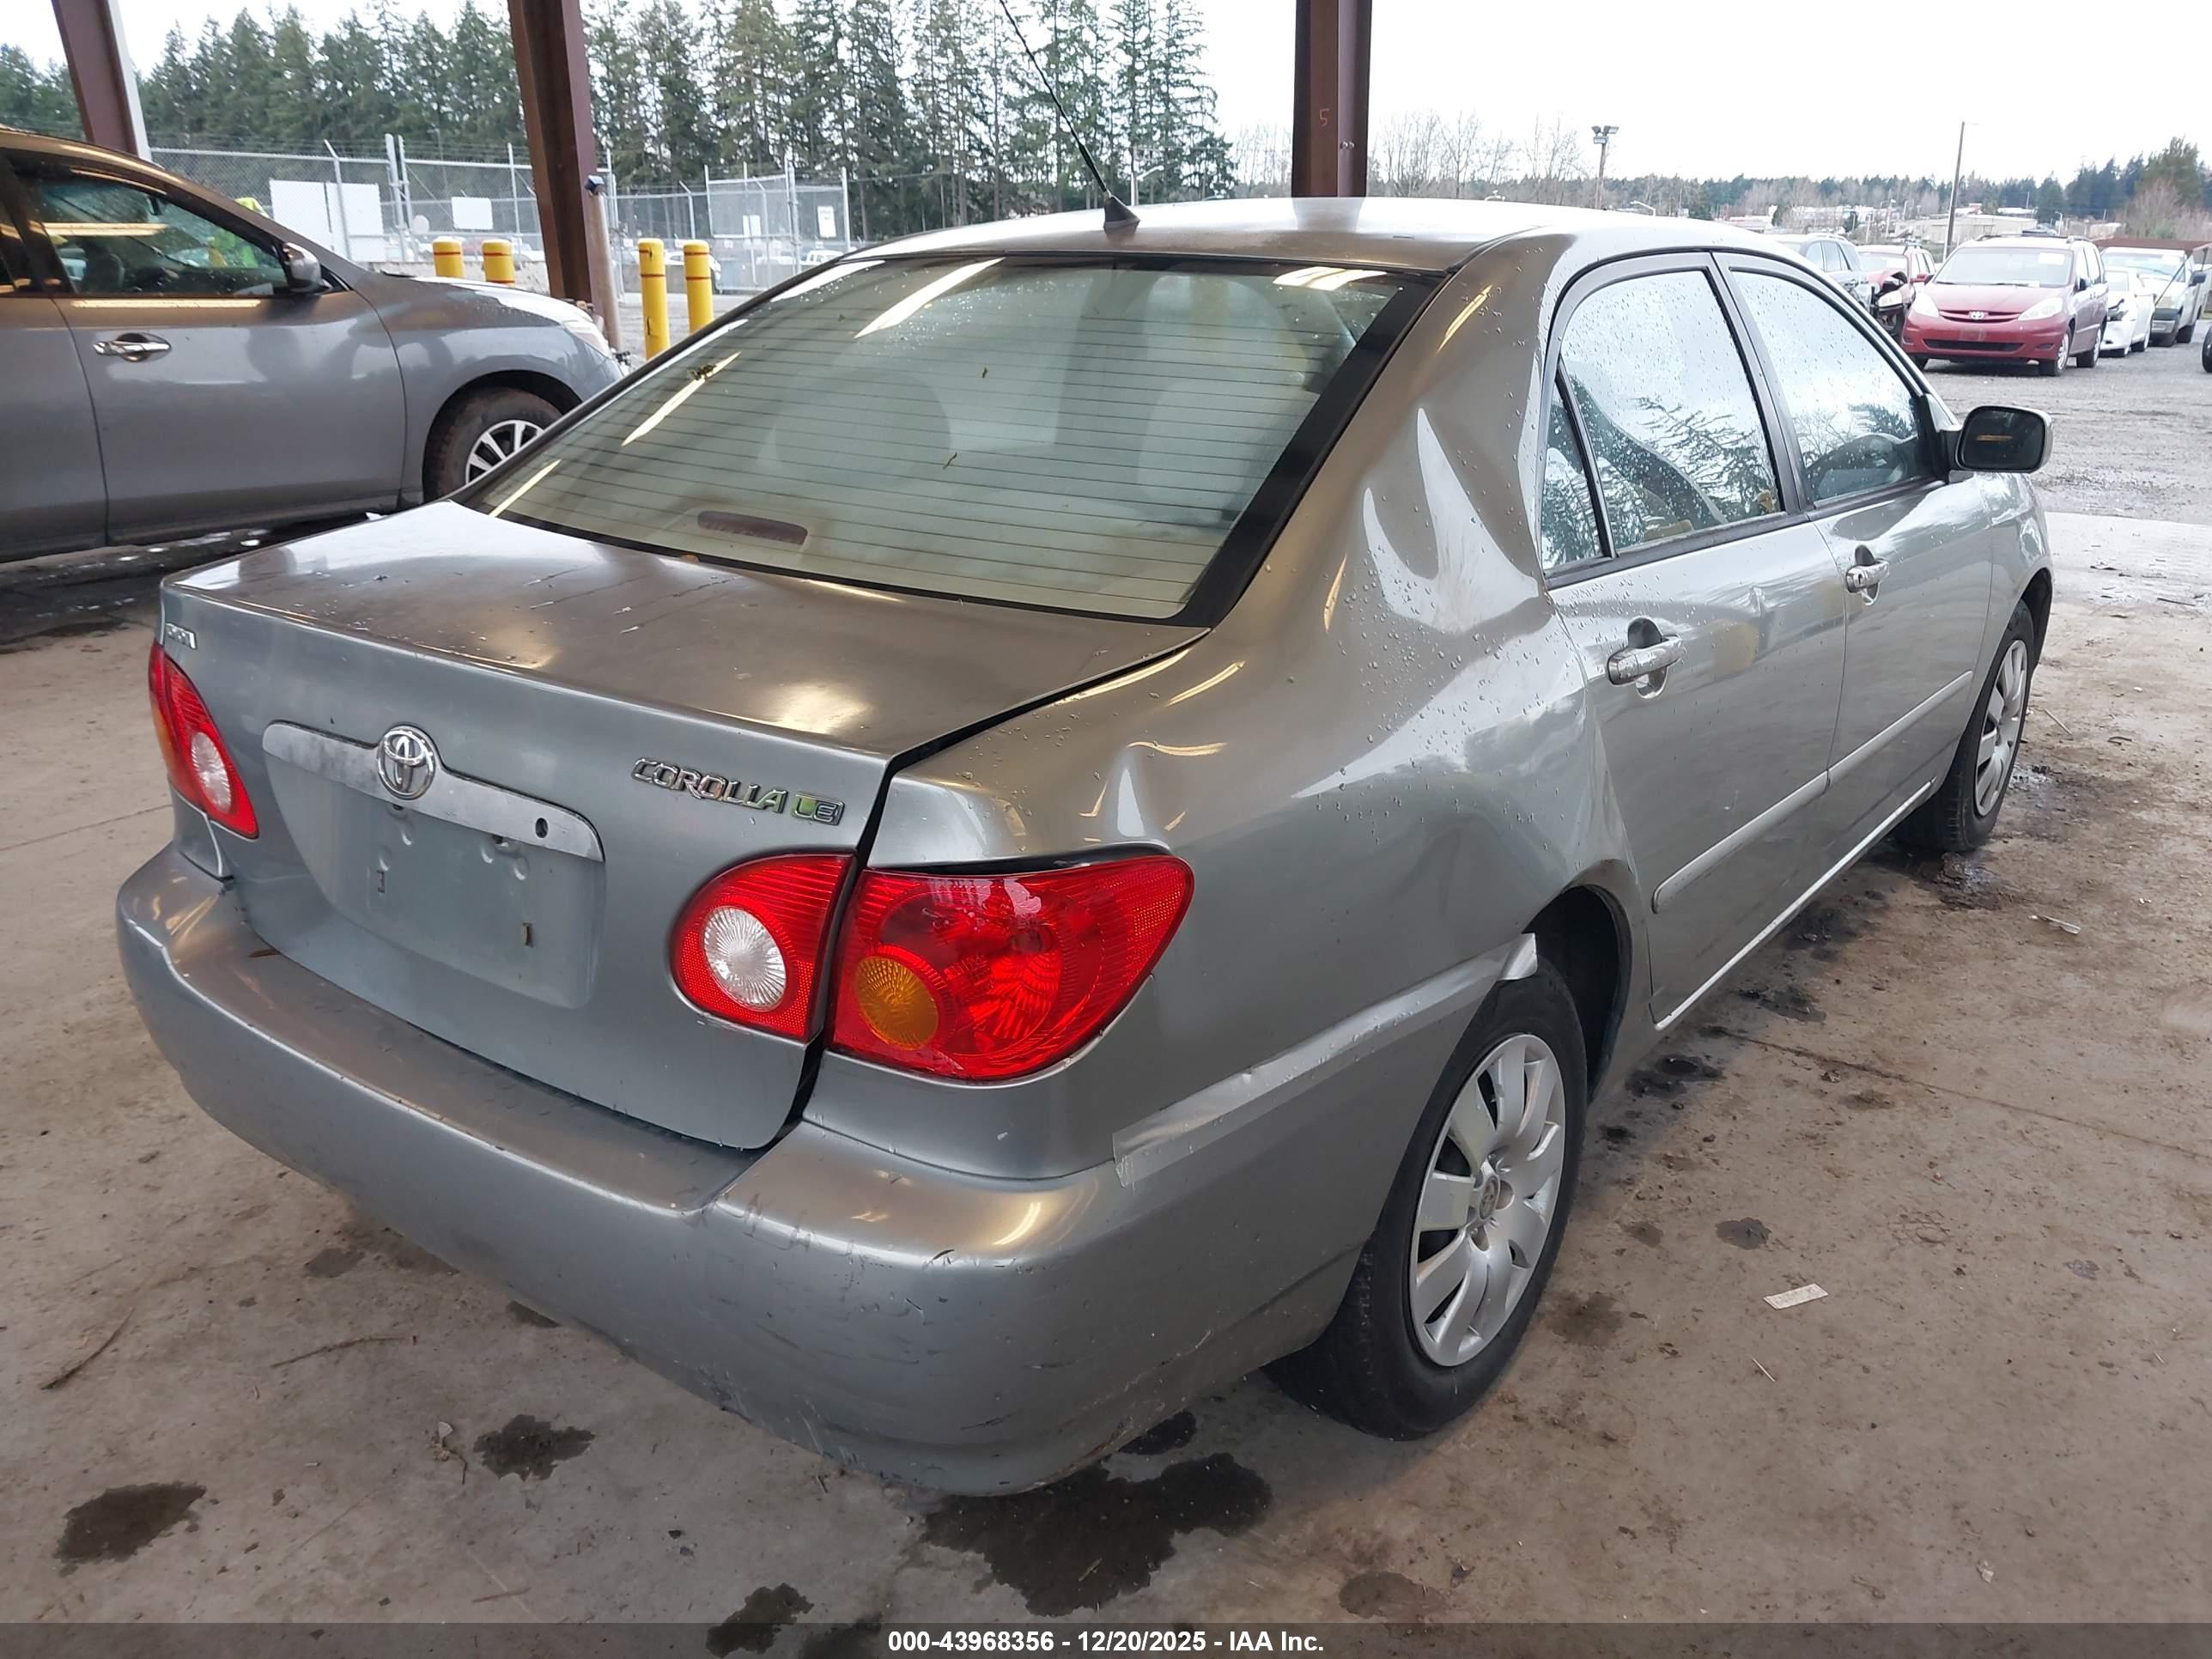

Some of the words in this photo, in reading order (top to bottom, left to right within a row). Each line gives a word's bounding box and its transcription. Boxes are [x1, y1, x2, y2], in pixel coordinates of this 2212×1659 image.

[1319, 108, 1330, 127] 5
[631, 757, 788, 814] COROLLA
[792, 792, 845, 825] LE
